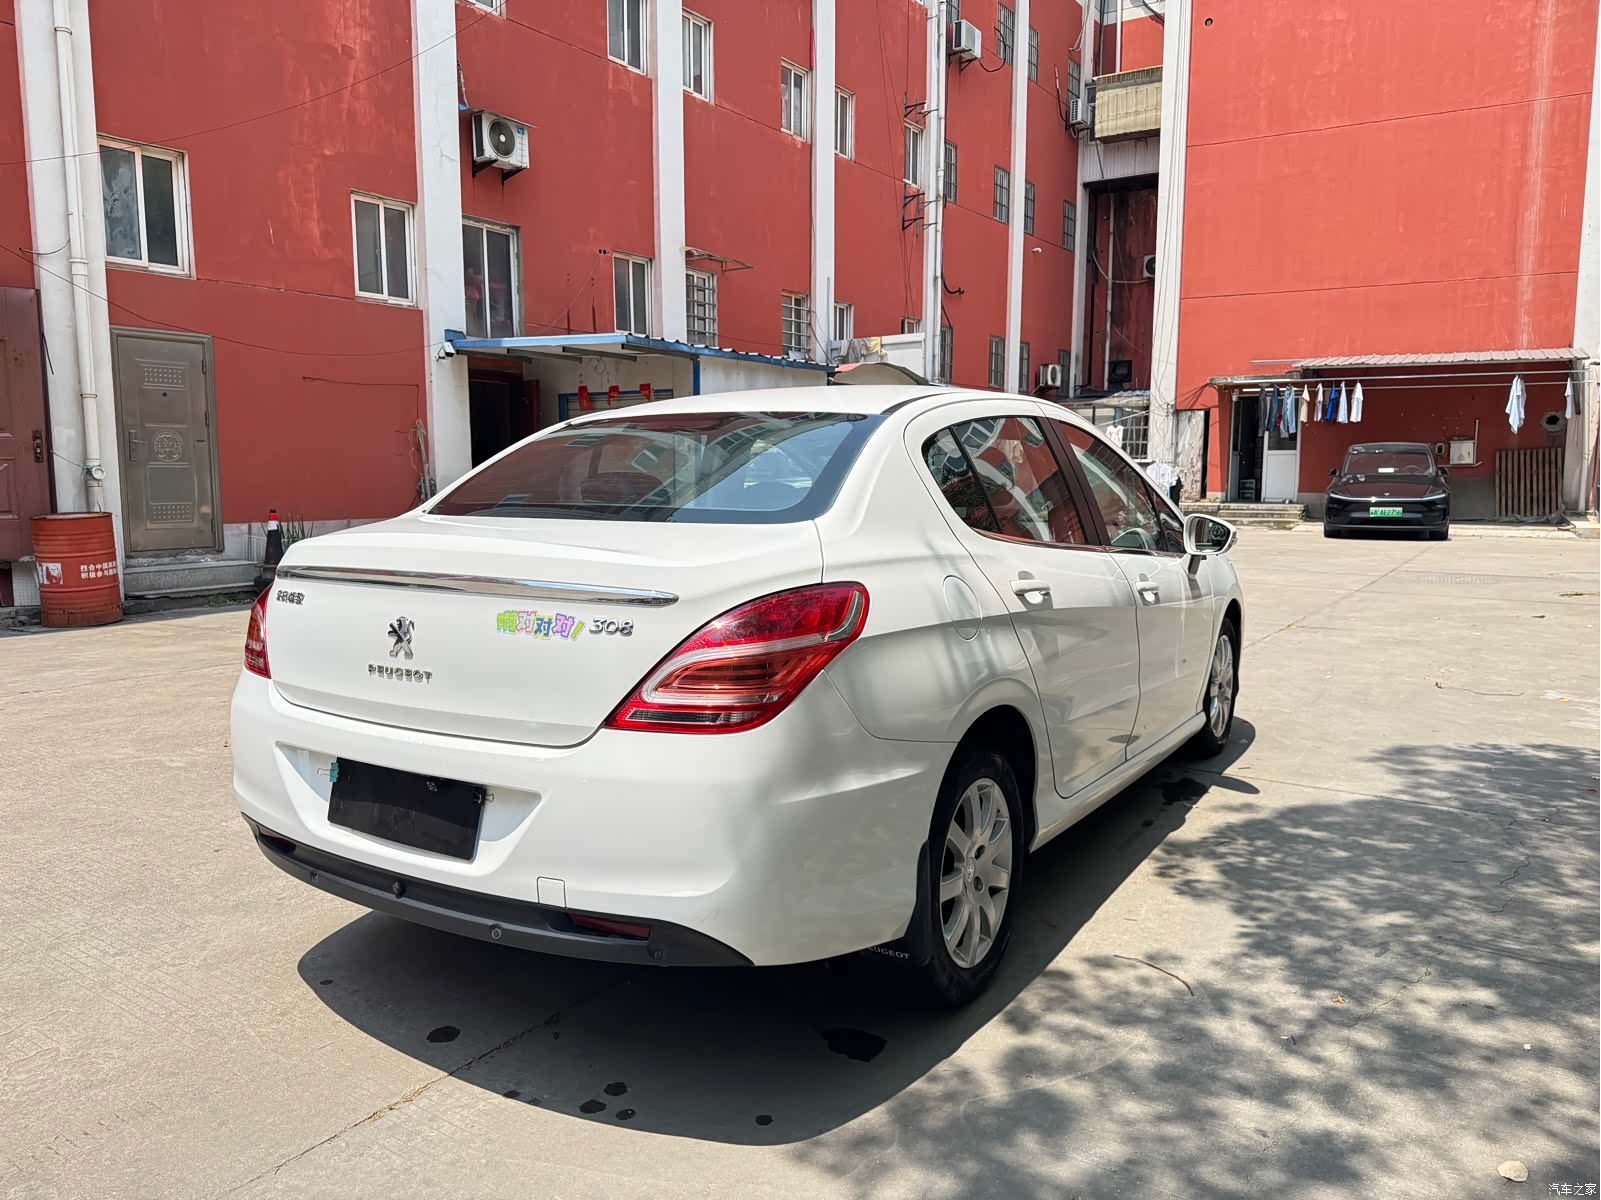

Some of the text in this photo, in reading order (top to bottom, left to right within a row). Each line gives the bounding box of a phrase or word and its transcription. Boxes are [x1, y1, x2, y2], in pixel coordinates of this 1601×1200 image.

[589, 617, 634, 637] 308
[368, 663, 433, 684] PEUGEOT
[868, 946, 910, 960] EUGEOT
